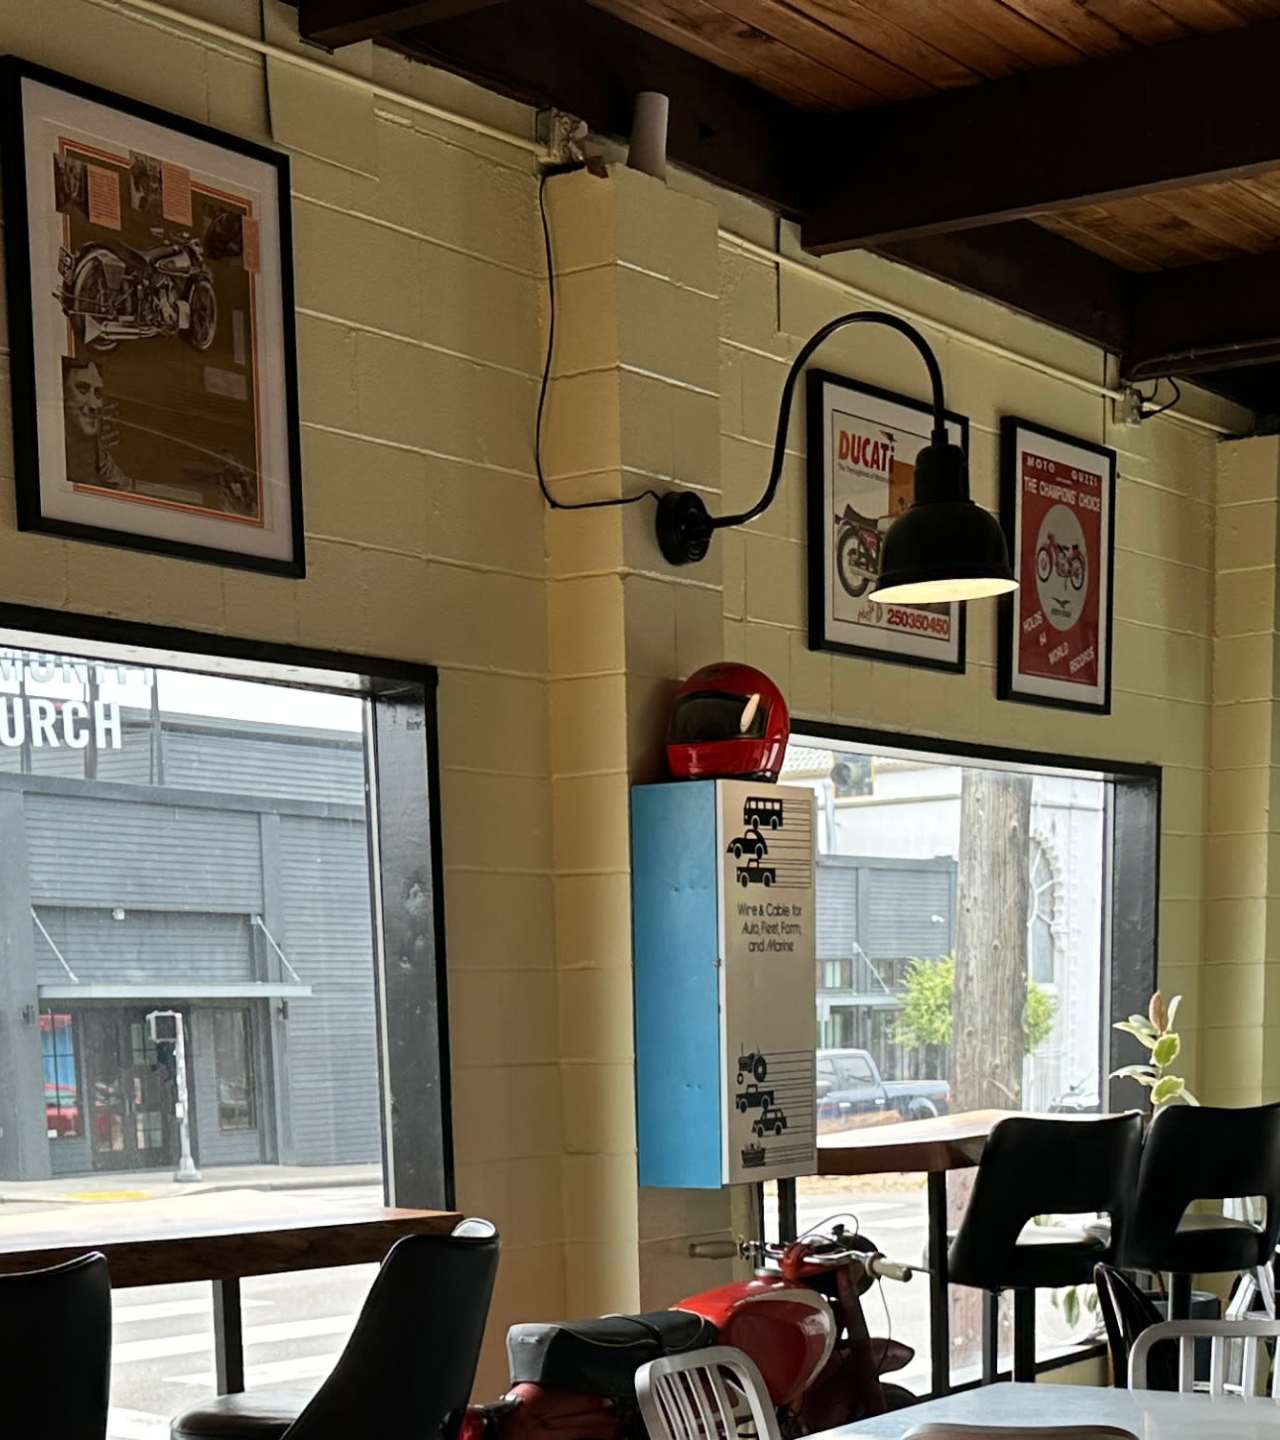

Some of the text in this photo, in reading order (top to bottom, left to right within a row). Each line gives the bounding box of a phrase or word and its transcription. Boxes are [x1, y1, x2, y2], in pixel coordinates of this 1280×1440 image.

[1027, 455, 1056, 474] MOTO
[1023, 475, 1038, 494] THE
[737, 903, 758, 916] Wire
[766, 902, 790, 917] Cable
[791, 904, 802, 916] for
[748, 939, 794, 952] and Marine
